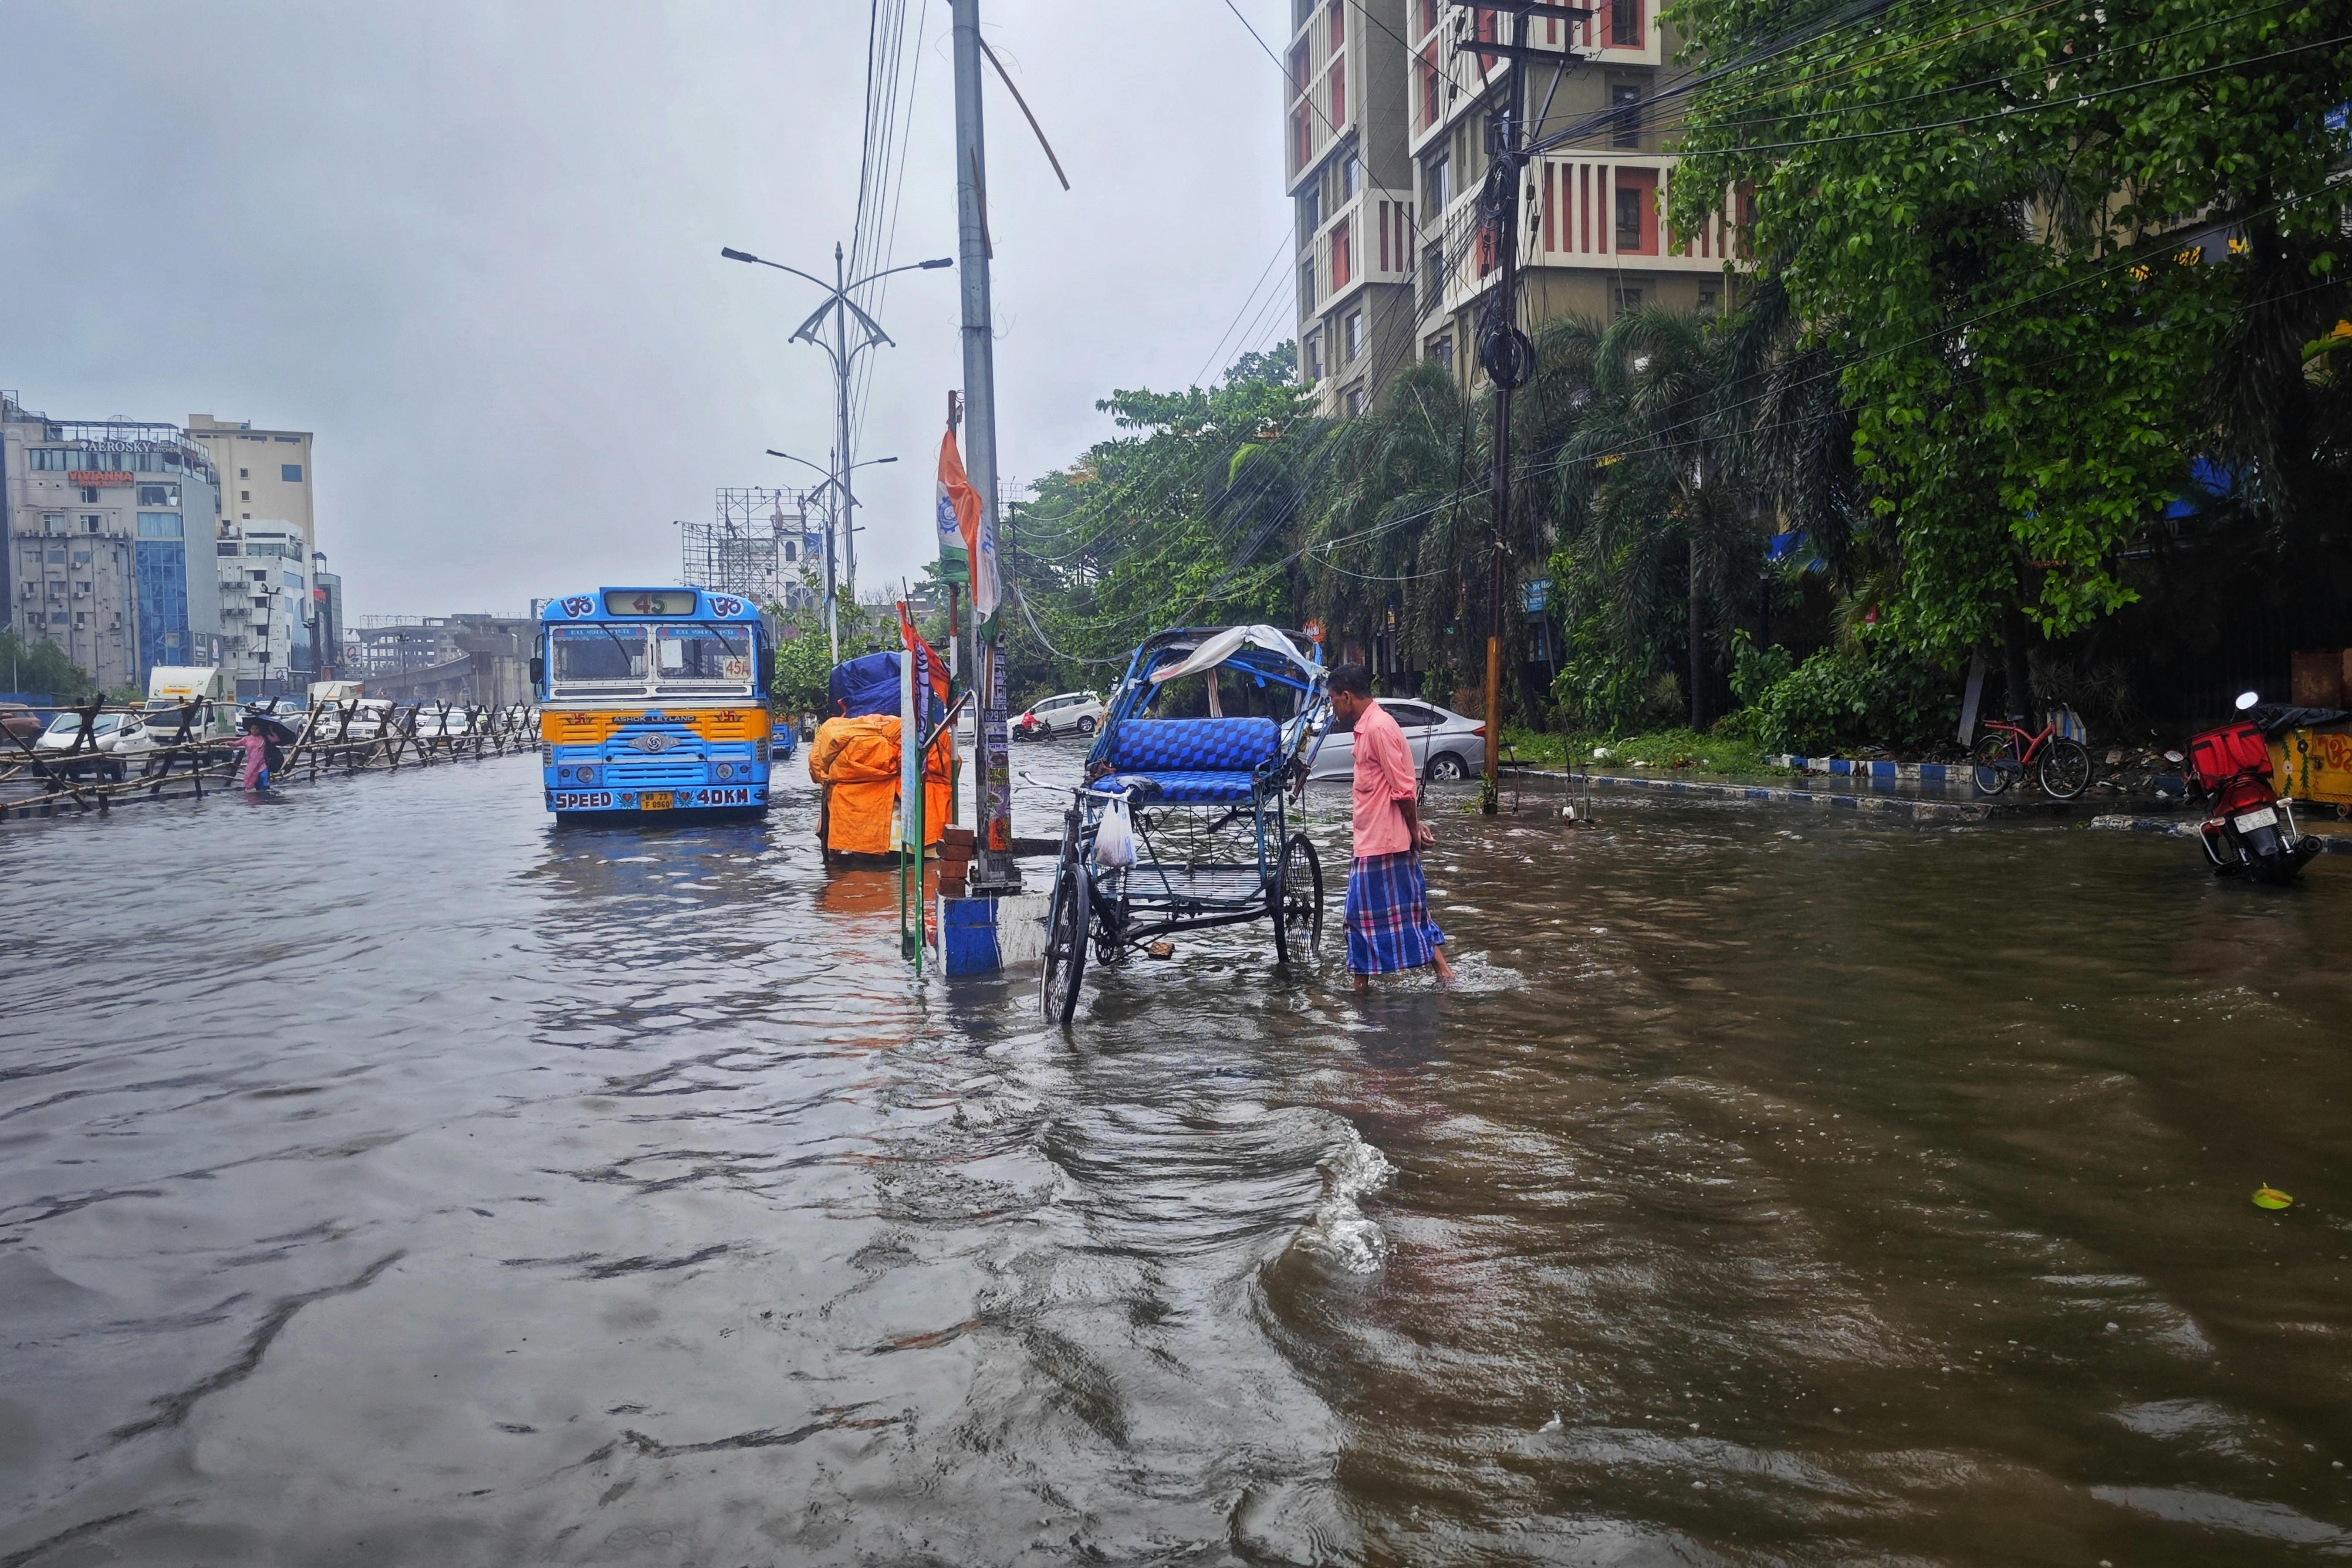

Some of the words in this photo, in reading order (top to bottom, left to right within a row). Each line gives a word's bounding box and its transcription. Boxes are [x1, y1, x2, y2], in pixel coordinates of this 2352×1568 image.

[89, 441, 151, 453] AEROSKY
[68, 471, 133, 480] VIVIANNA
[632, 594, 664, 614] 45
[726, 661, 749, 675] 45A
[556, 792, 613, 808] SPEED
